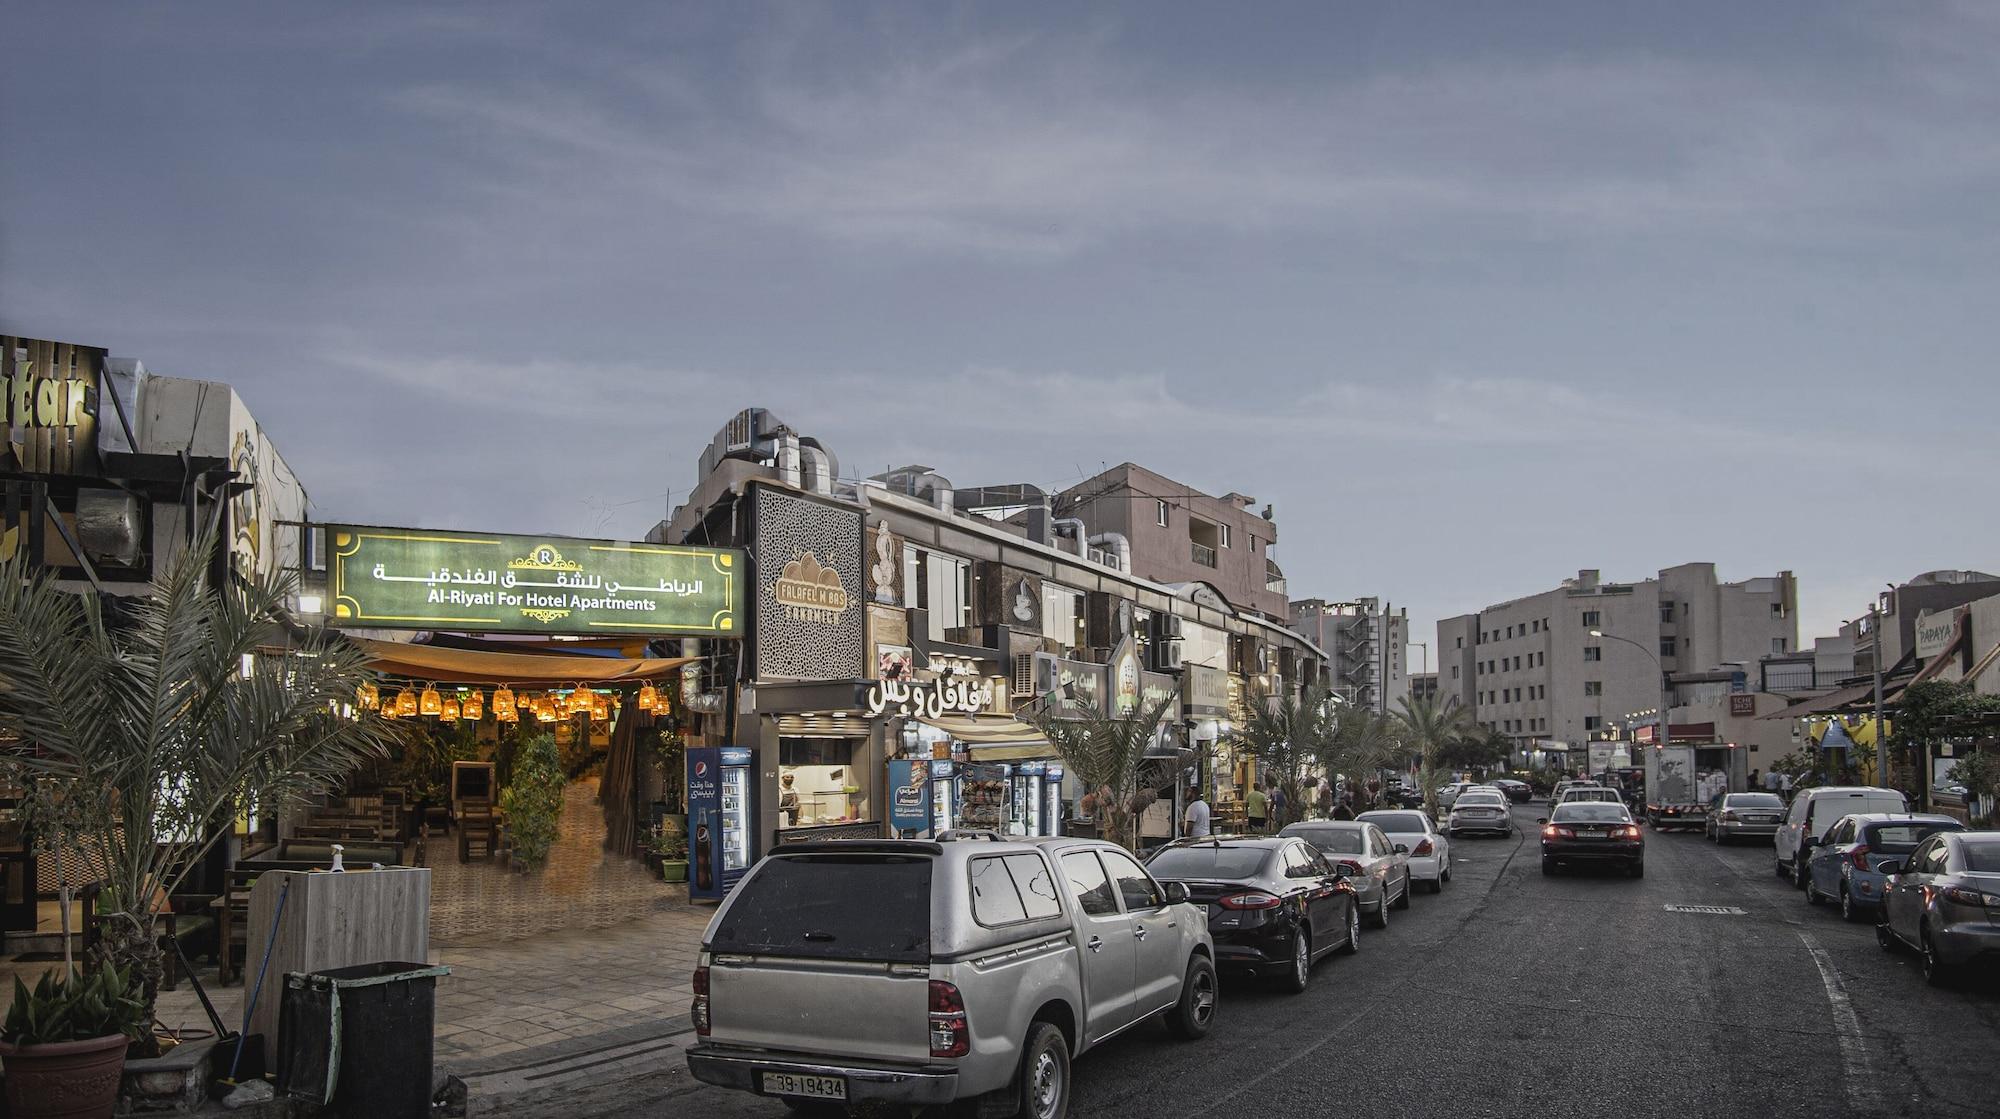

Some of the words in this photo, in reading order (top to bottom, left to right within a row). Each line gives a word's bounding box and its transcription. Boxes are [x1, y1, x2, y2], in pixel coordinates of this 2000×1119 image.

[373, 563, 497, 587] الفندقية
[501, 570, 601, 589] للشقق
[427, 589, 494, 607] Al-Riyati
[498, 592, 523, 606] For
[526, 593, 567, 608] Hotel
[570, 595, 656, 612] Apartments
[781, 584, 817, 602] FALAFEL
[829, 592, 844, 605] BAS
[1919, 622, 1952, 643] PAPAYA
[1391, 631, 1399, 681] HOTEL
[927, 678, 981, 720] فلافل
